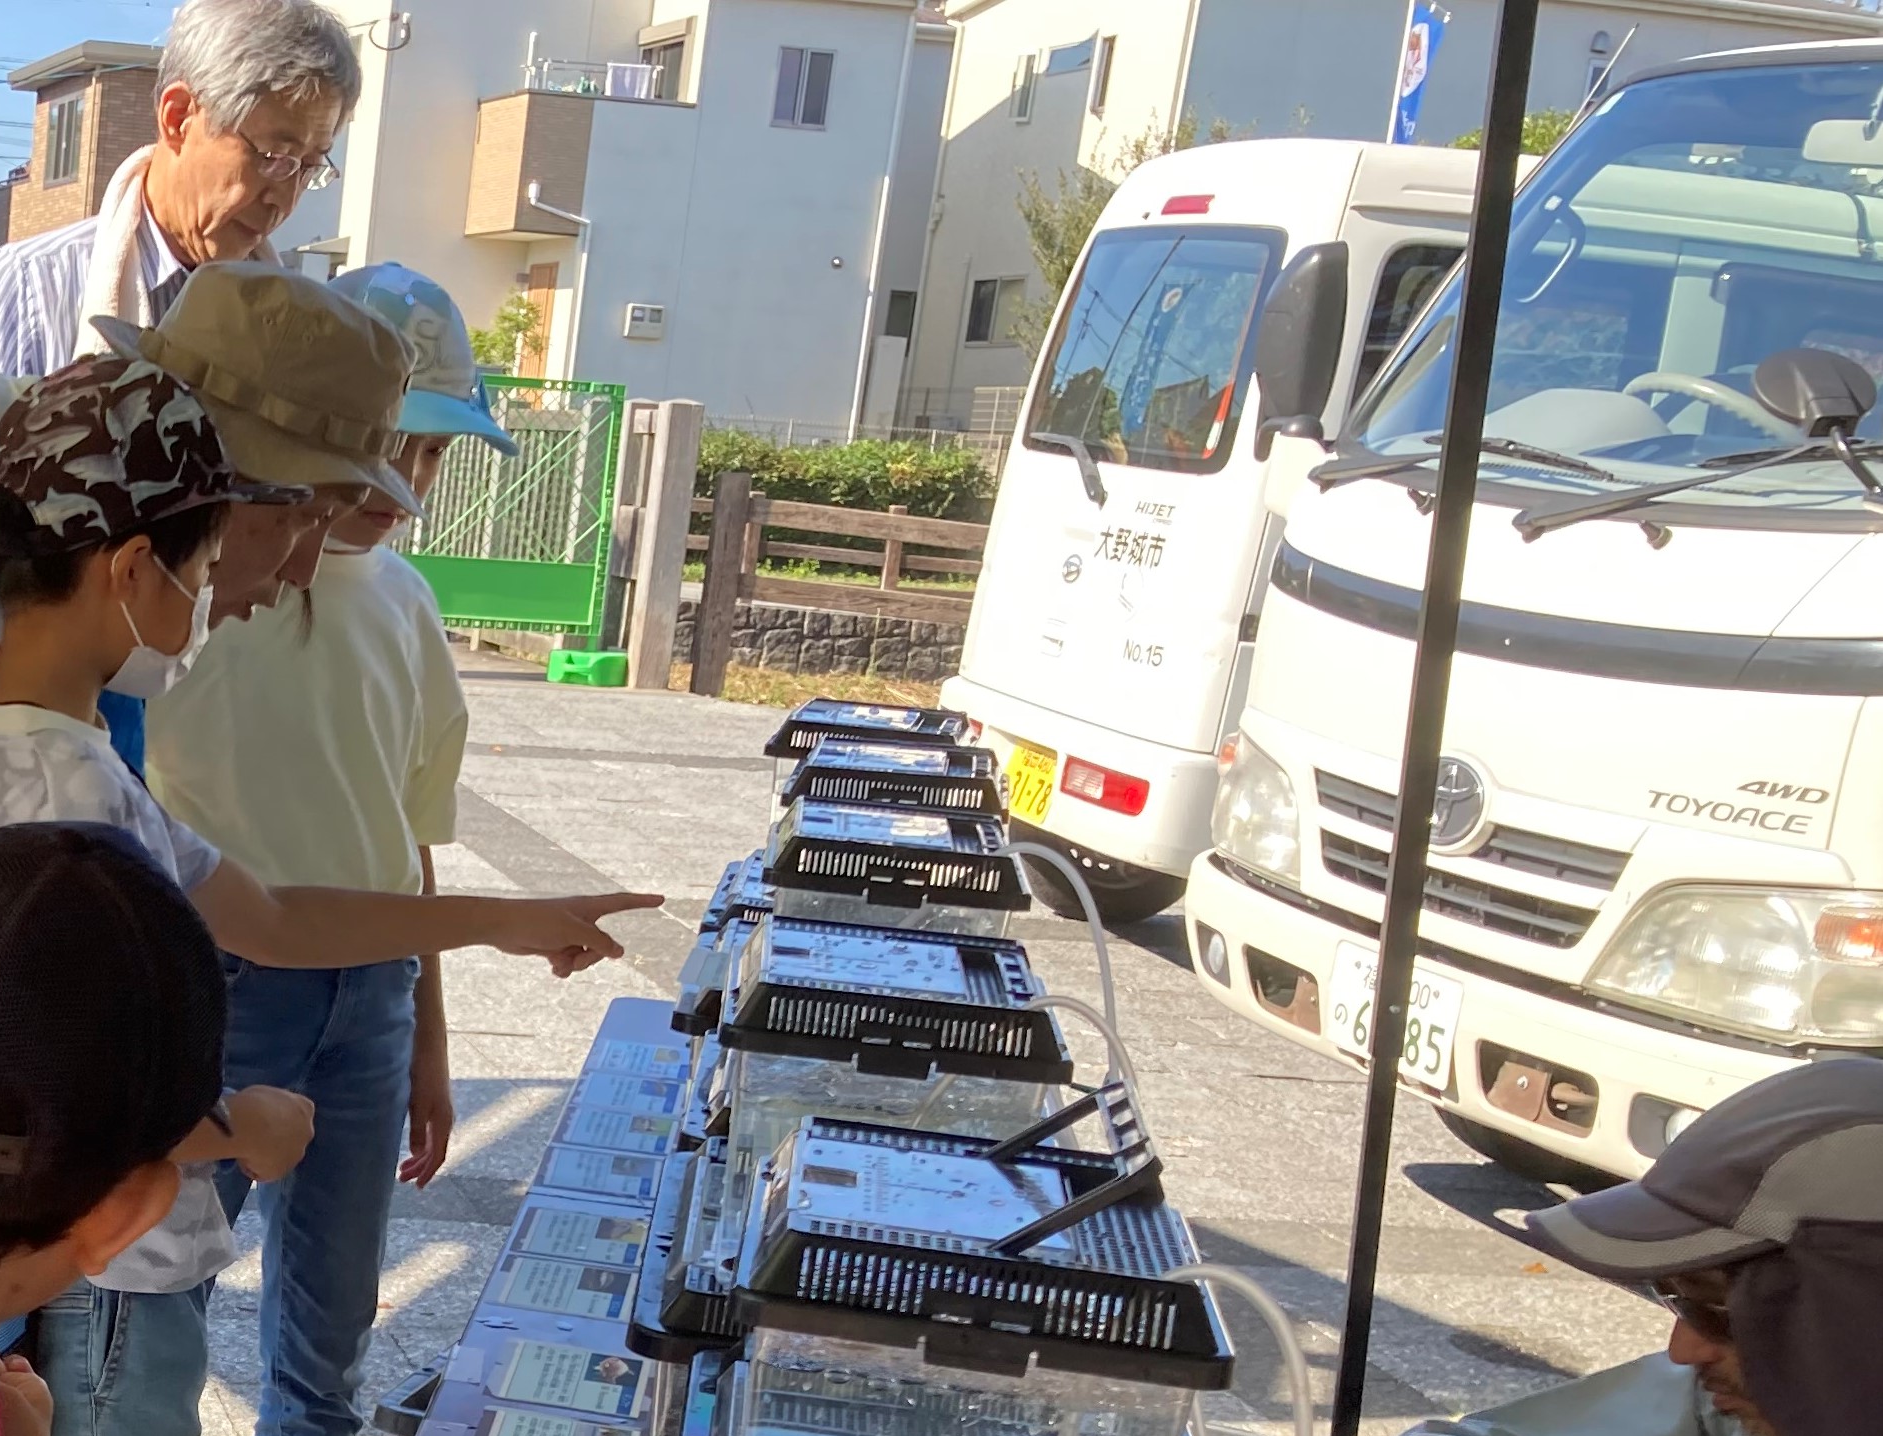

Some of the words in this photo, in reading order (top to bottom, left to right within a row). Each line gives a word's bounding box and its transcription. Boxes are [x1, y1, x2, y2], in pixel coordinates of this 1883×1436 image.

[1135, 501, 1176, 517] HIJET
[1093, 526, 1166, 569] 大野城市
[1648, 789, 1813, 835] TOYOACE
[1737, 780, 1830, 805] 4WD
[1364, 964, 1377, 990] 福
[1409, 981, 1431, 1009] 00
[1335, 1003, 1348, 1024] の
[1353, 1000, 1445, 1075] 685
